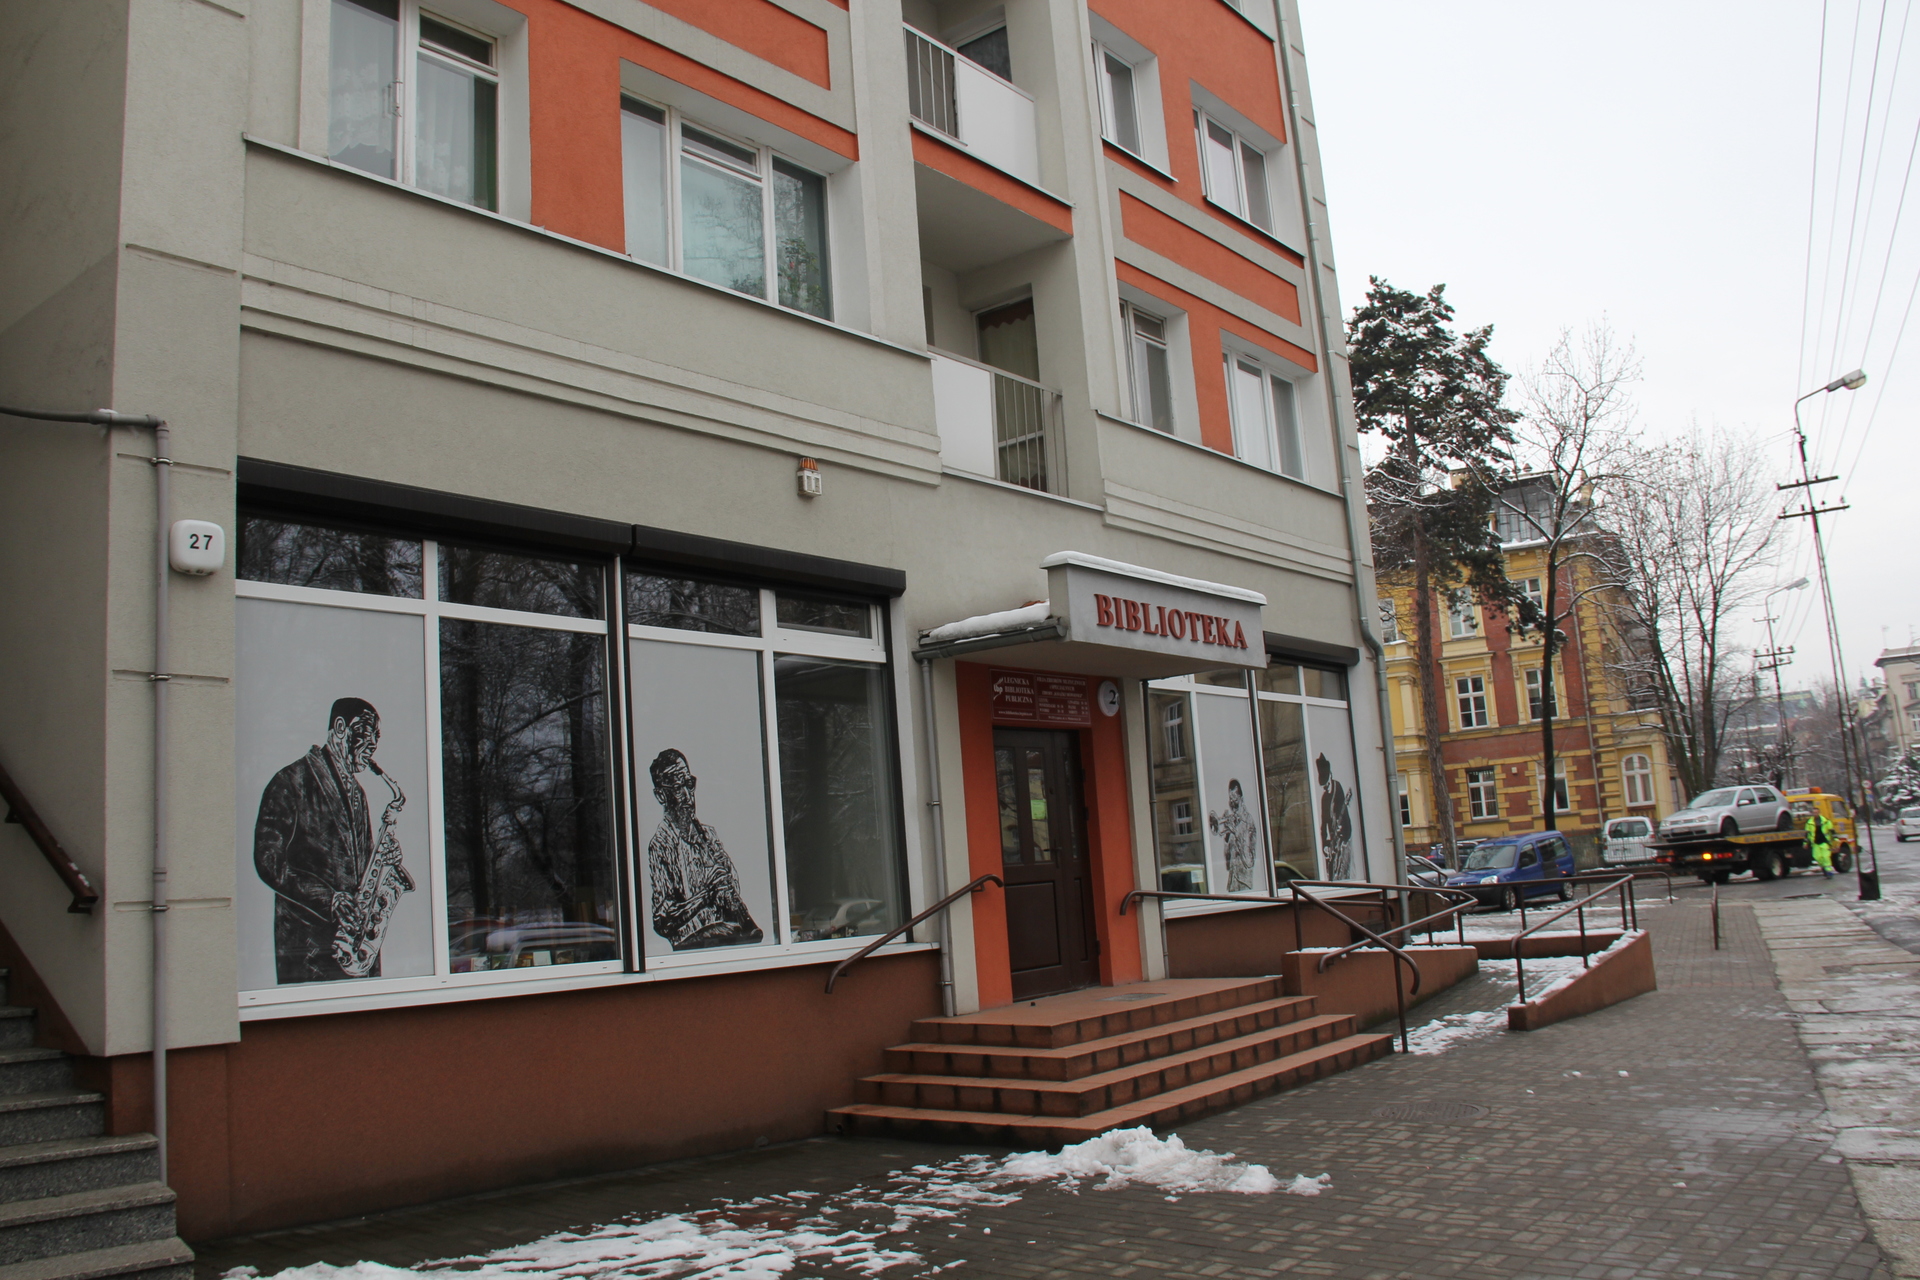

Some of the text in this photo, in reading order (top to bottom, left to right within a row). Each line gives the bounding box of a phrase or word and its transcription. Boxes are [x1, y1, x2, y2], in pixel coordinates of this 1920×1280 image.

[189, 533, 213, 550] 27
[1093, 593, 1249, 649] BIBLIOTEKA
[1004, 676, 1030, 686] LEGNICKA
[1004, 685, 1035, 695] BIBLIOTEKA
[1005, 695, 1033, 704] PUBLICZNA
